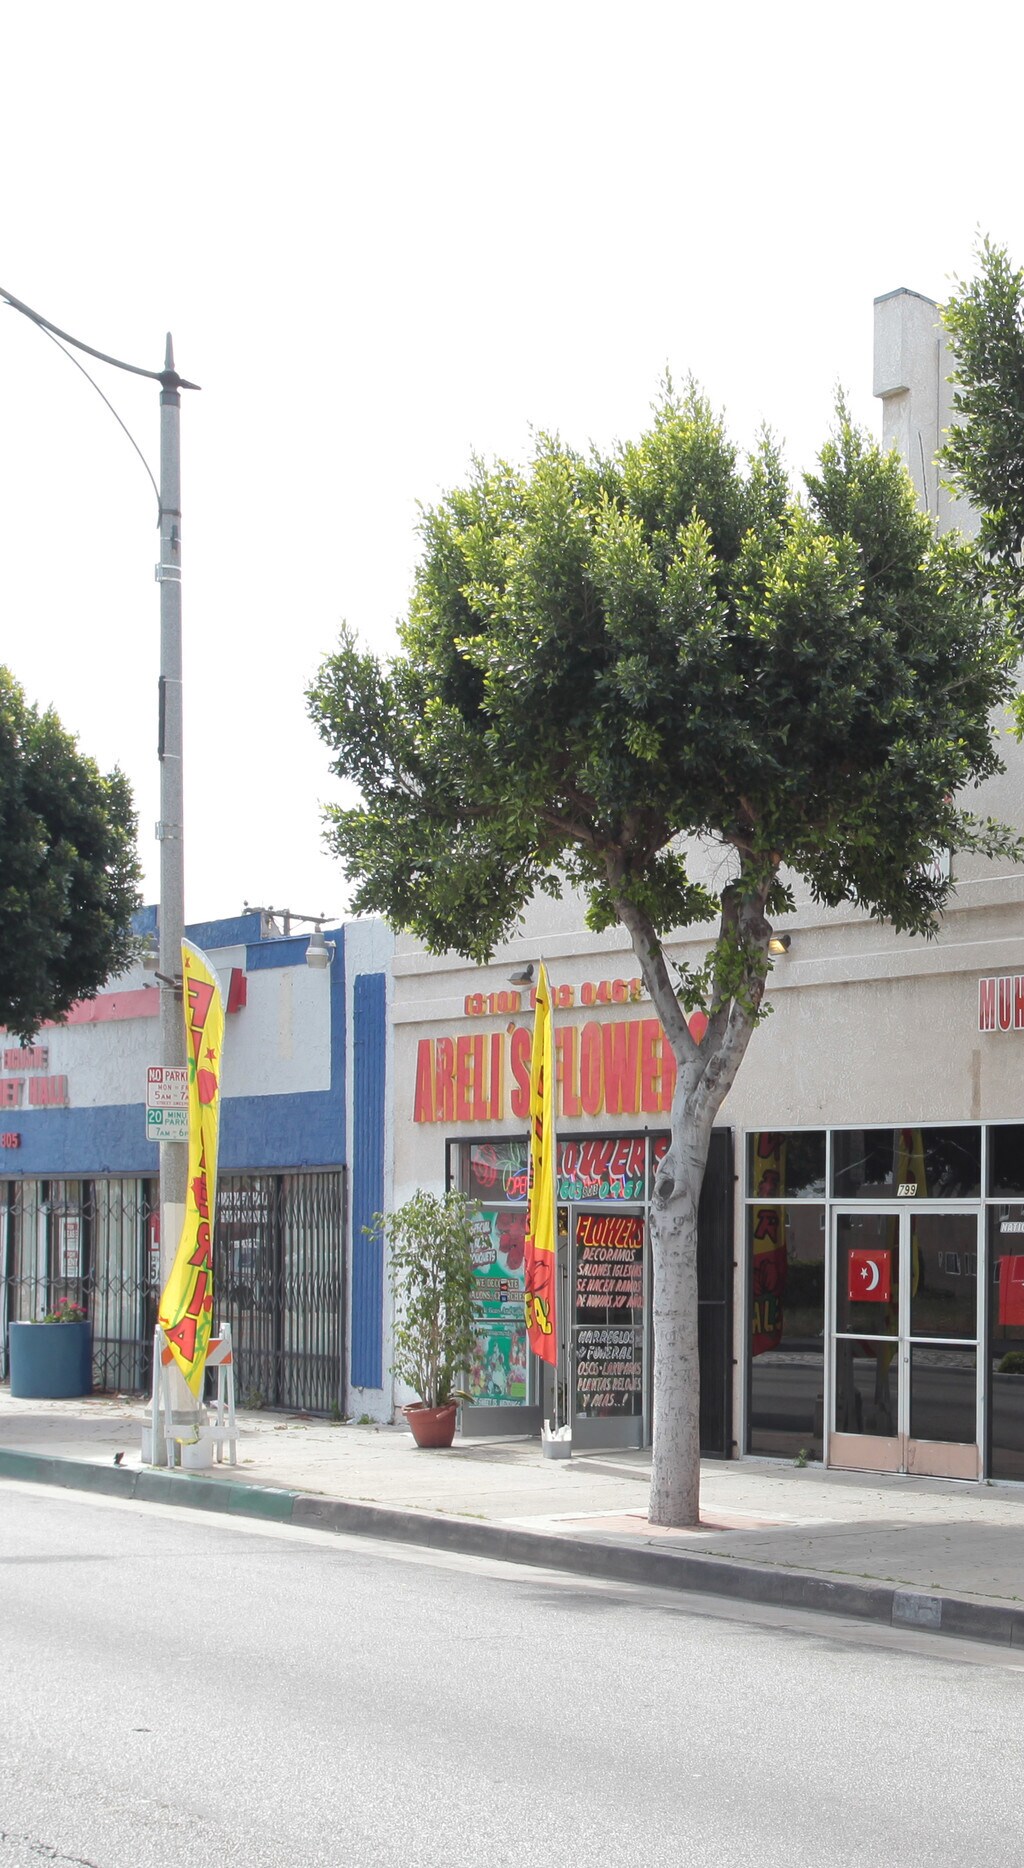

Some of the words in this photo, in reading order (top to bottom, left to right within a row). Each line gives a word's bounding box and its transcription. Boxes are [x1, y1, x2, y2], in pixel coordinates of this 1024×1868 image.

[465, 991, 520, 1016] (310)
[581, 978, 641, 1006] 0461
[149, 1069, 162, 1082] NO
[165, 1071, 188, 1081] PARKI
[413, 1022, 532, 1122] ARELI'S
[155, 1091, 171, 1100] 5AM
[180, 1092, 189, 1100] 7A
[149, 1111, 162, 1123] 20
[156, 1128, 170, 1136] 7AM
[599, 1180, 642, 1199] 0461
[898, 1185, 916, 1196] 799
[576, 1216, 645, 1248] FLOWERS
[583, 1248, 635, 1262] DECORAMOS
